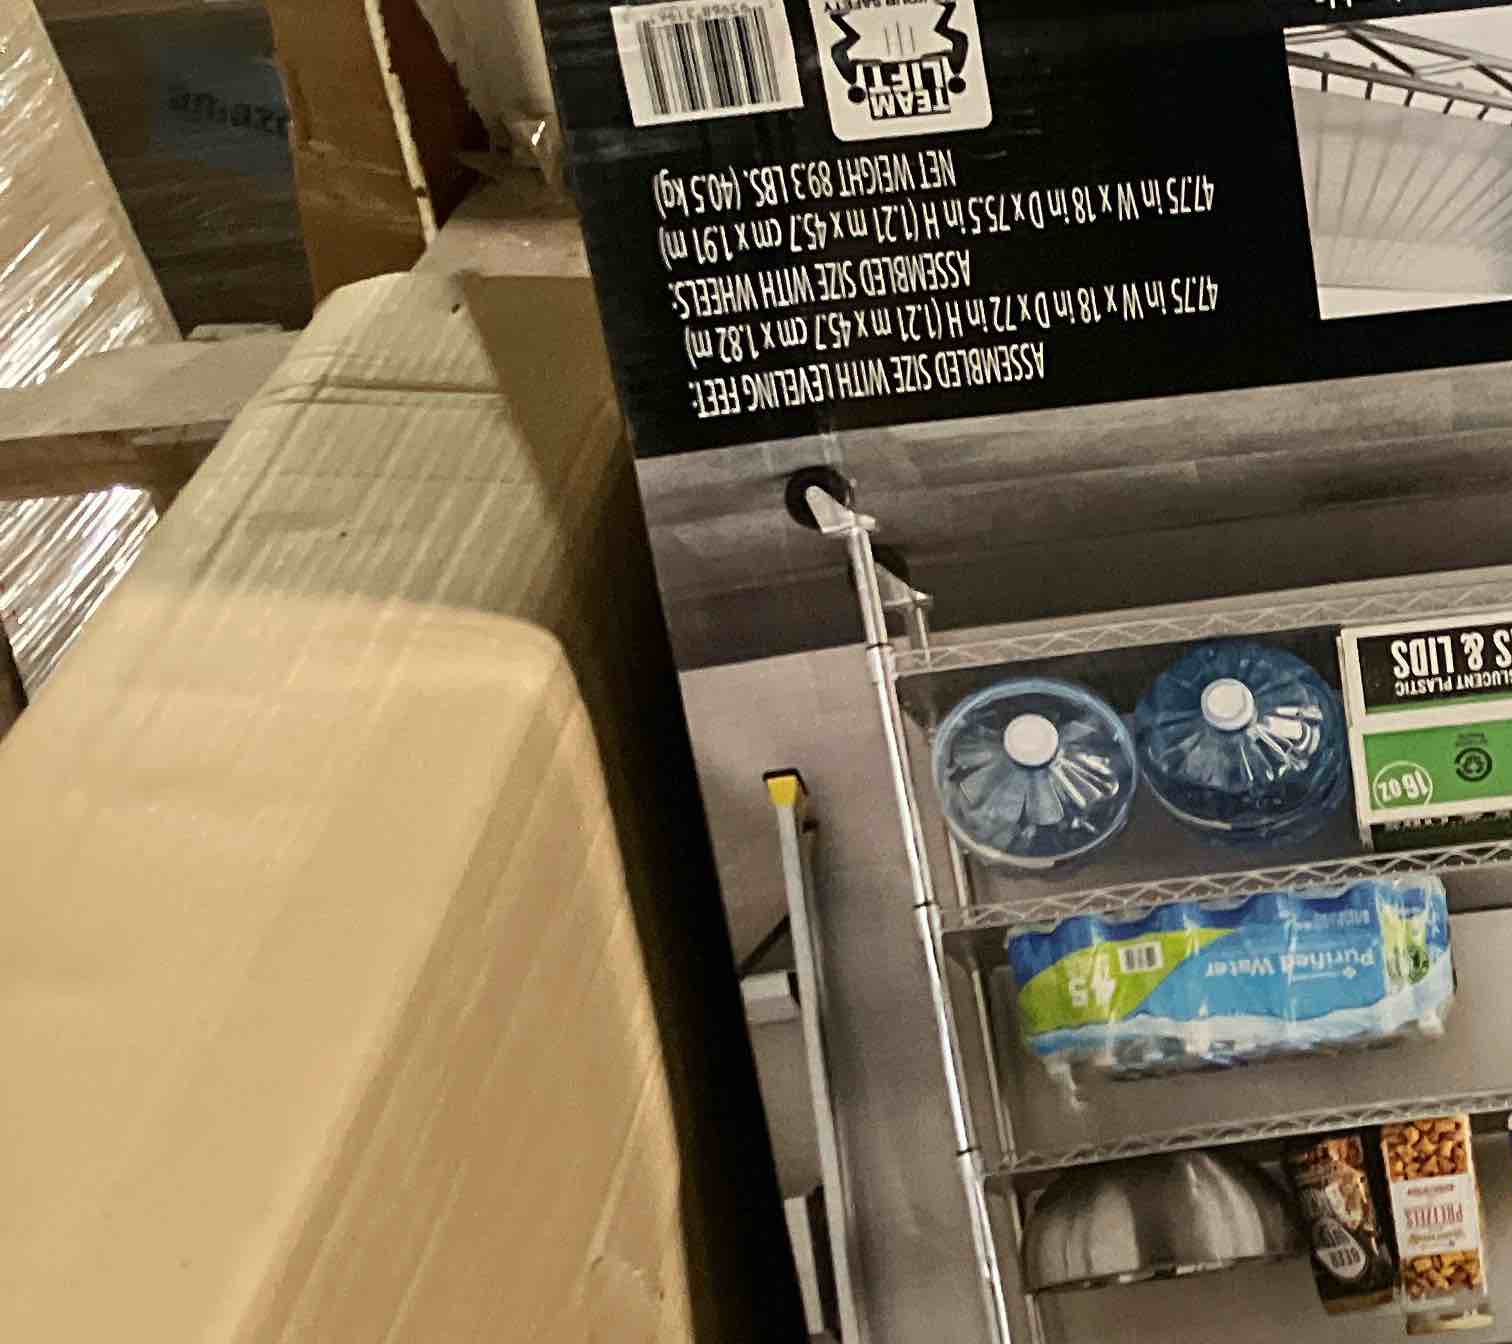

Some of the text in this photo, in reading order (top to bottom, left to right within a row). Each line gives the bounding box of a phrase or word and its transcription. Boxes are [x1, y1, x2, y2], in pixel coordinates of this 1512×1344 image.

[869, 58, 945, 93] LIFT
[870, 86, 951, 118] TEAM
[654, 149, 956, 217] NET WEIGHT 89.3 LBS. (40.5 kg)
[659, 175, 1215, 270] 47.75 in W x 18 in D x 75.5 in H (1.21 m x 45.7 cm x 1.91 m)
[668, 249, 970, 319] ASSEMBLED SIZE WITH WHEELS:
[685, 275, 1218, 369] 47.75 in W x 18 in D x 72 in H (1.21 m x 45.7 cm x 1.82 m)
[688, 341, 1044, 419] ASSEMBLED SIZE WITH LEVELING FEET:
[1390, 635, 1455, 679] LIDS
[1460, 632, 1485, 671] &
[1394, 675, 1453, 697] PLASTIC
[1205, 947, 1375, 977] Purified Water
